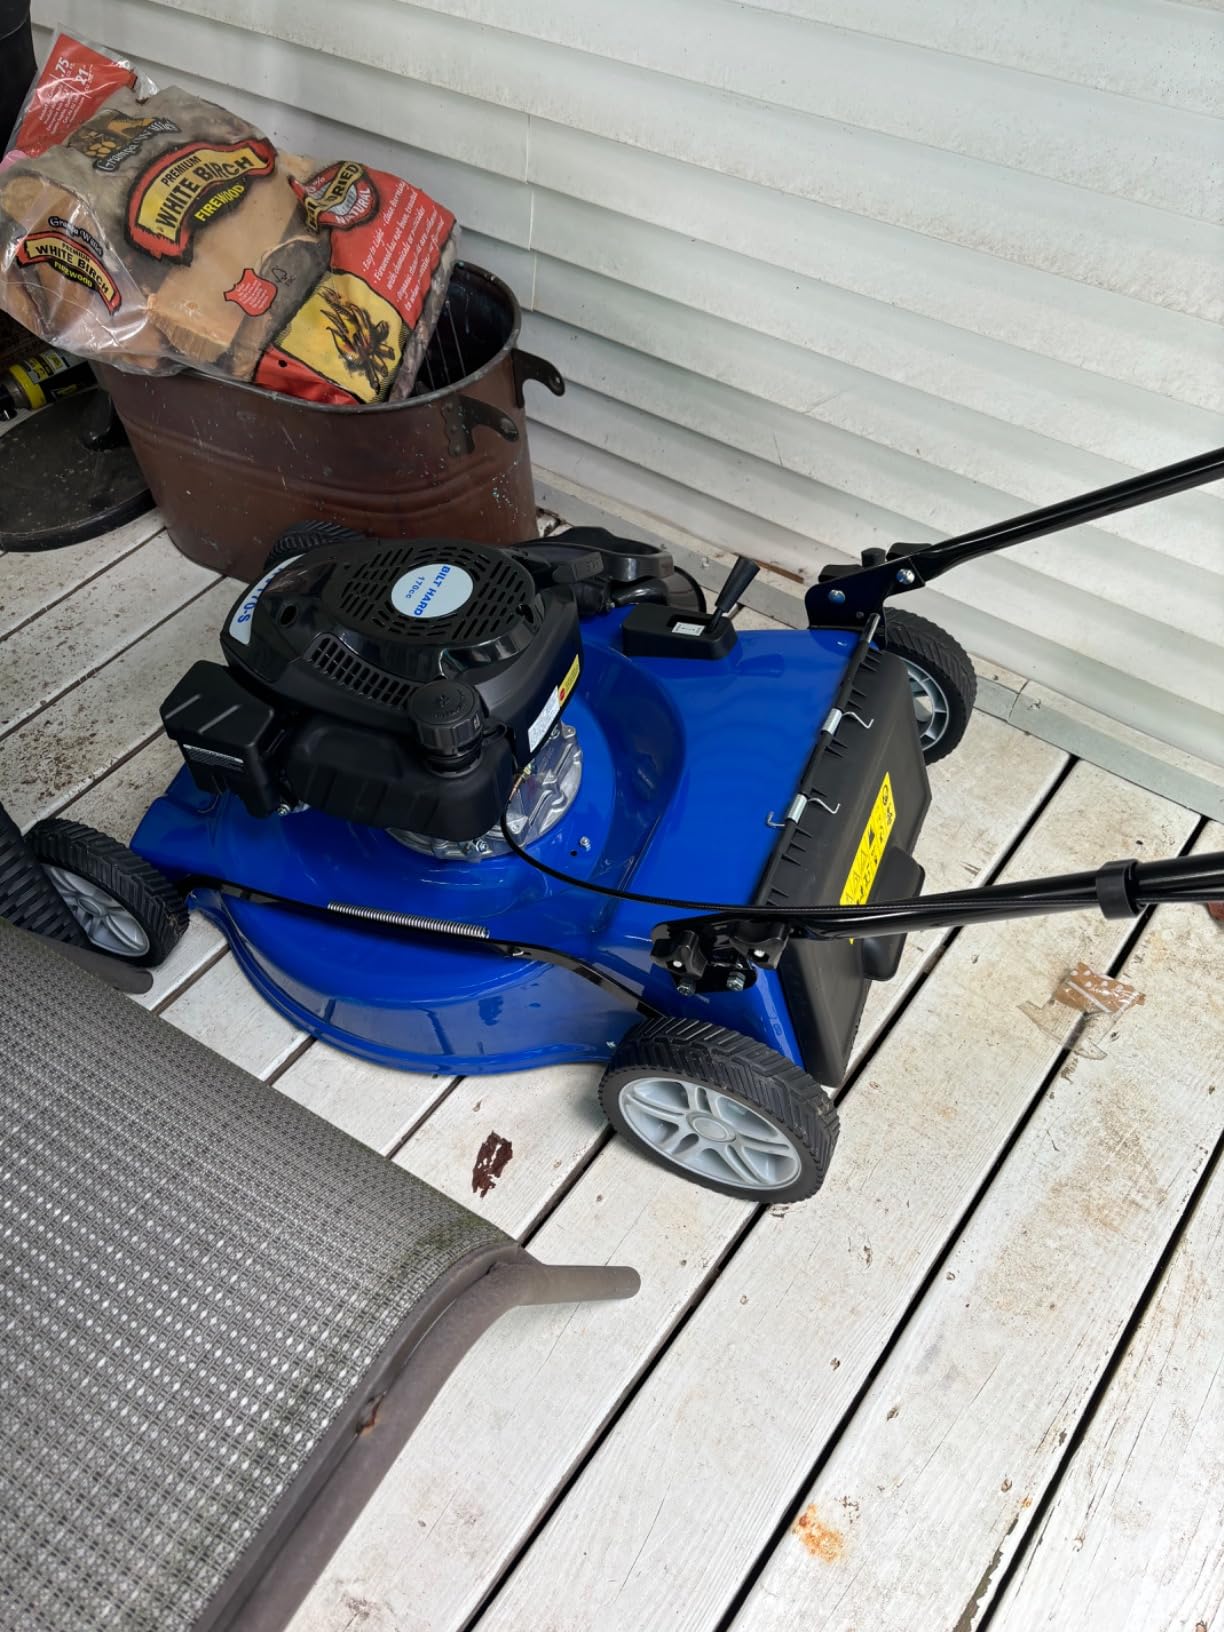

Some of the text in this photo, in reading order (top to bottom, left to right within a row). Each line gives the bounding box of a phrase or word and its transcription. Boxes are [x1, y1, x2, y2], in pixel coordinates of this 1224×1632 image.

[161, 155, 202, 186] PREMIUM
[155, 156, 254, 228] WHITE BIRCH
[194, 183, 246, 221] FIREWOOD
[336, 187, 371, 225] NATURAL
[36, 245, 108, 293] WHITE BIRCH
[405, 576, 425, 599] 170cc
[414, 566, 451, 616] BILT HARD
